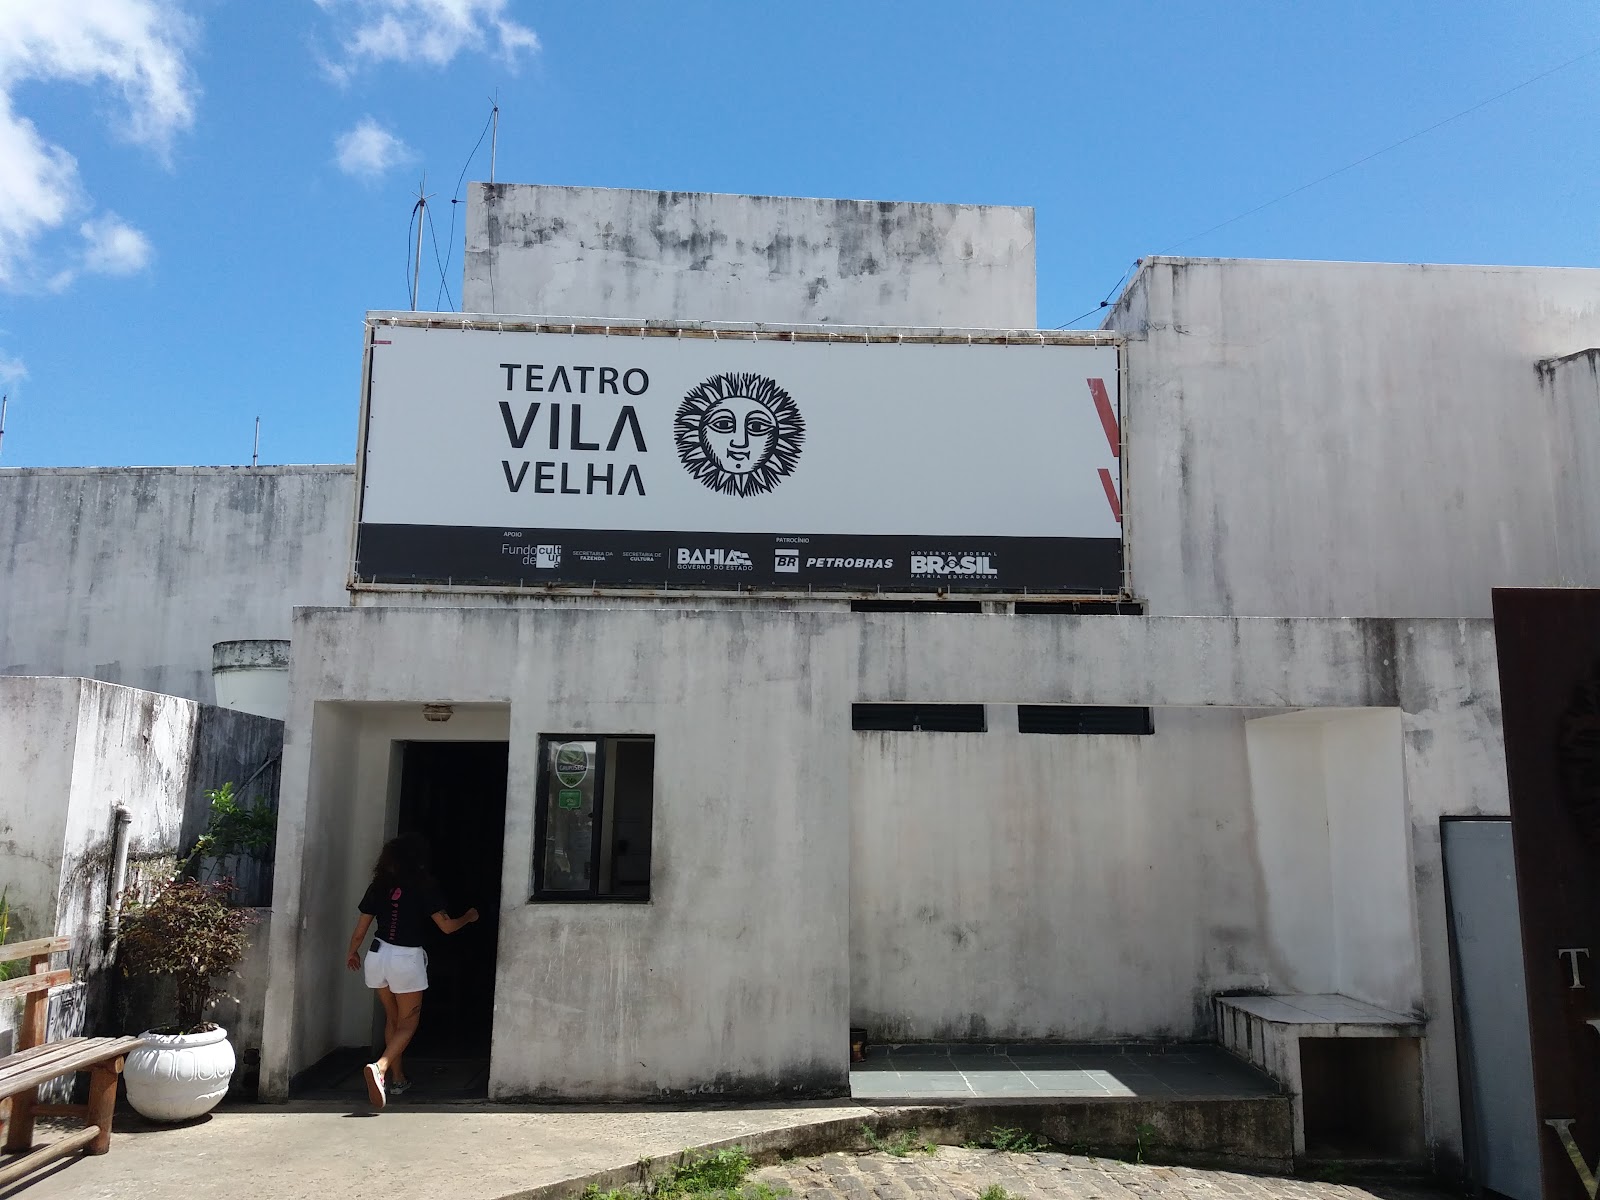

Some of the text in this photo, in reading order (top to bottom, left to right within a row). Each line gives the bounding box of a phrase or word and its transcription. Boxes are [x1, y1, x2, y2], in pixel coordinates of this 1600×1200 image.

[499, 363, 649, 396] TEATRO
[498, 401, 648, 453] VILA
[501, 460, 646, 496] VELHA
[501, 543, 537, 555] Fundo
[677, 548, 741, 565] BAHIA
[522, 554, 537, 565] de
[777, 557, 797, 567] BR
[806, 558, 894, 569] PETROBRAS
[910, 555, 998, 575] BRASIL
